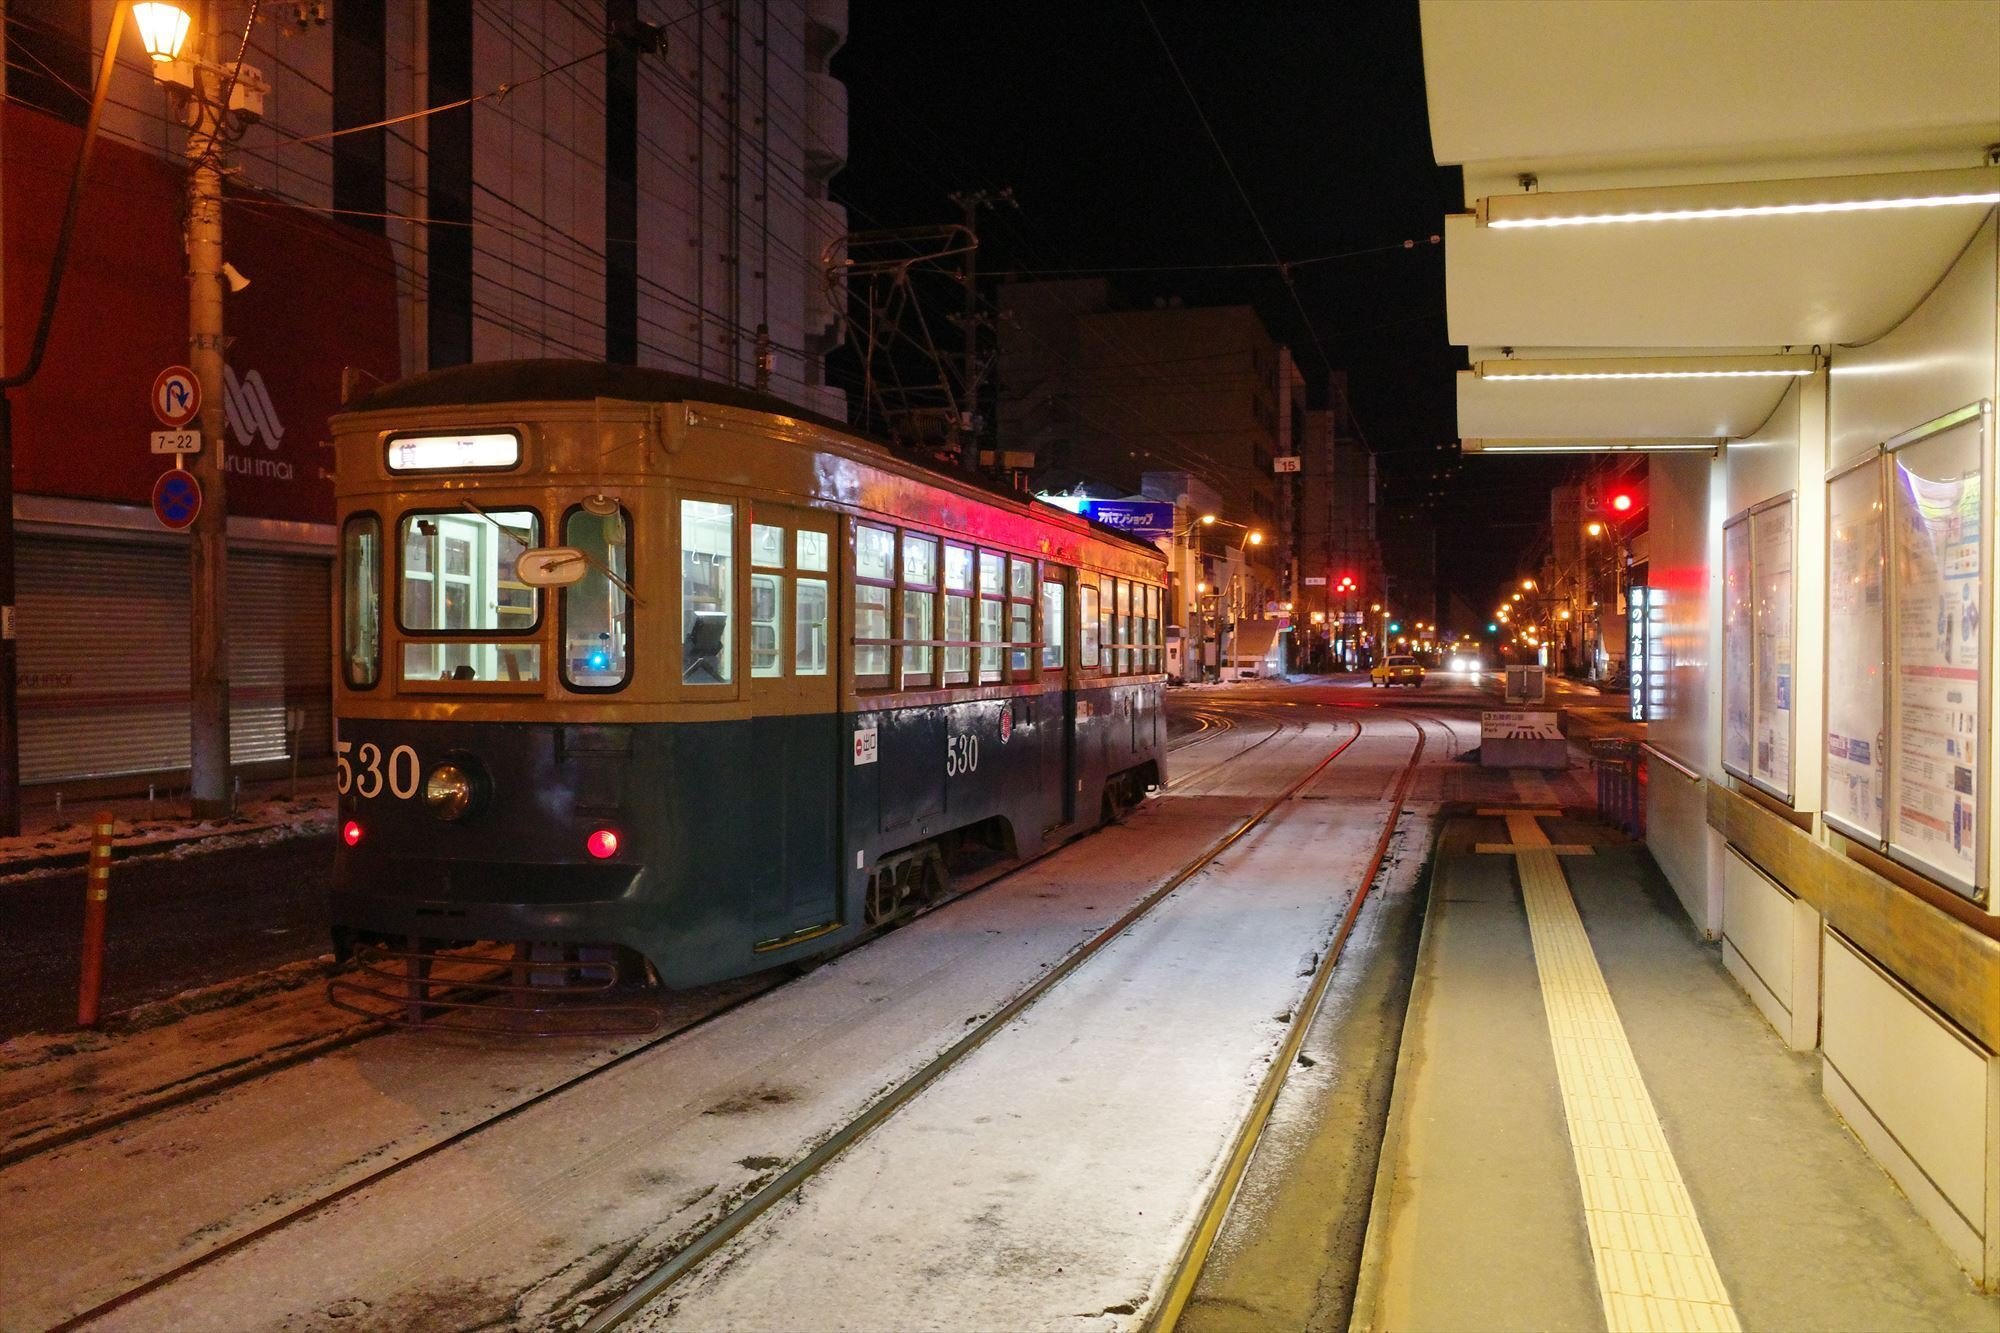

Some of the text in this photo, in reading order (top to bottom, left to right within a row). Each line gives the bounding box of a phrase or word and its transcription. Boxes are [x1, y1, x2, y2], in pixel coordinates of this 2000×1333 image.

[158, 435, 192, 449] 7-22
[1282, 461, 1296, 471] 15
[863, 733, 876, 752] 出口
[946, 734, 978, 777] 530
[337, 741, 420, 800] 530
